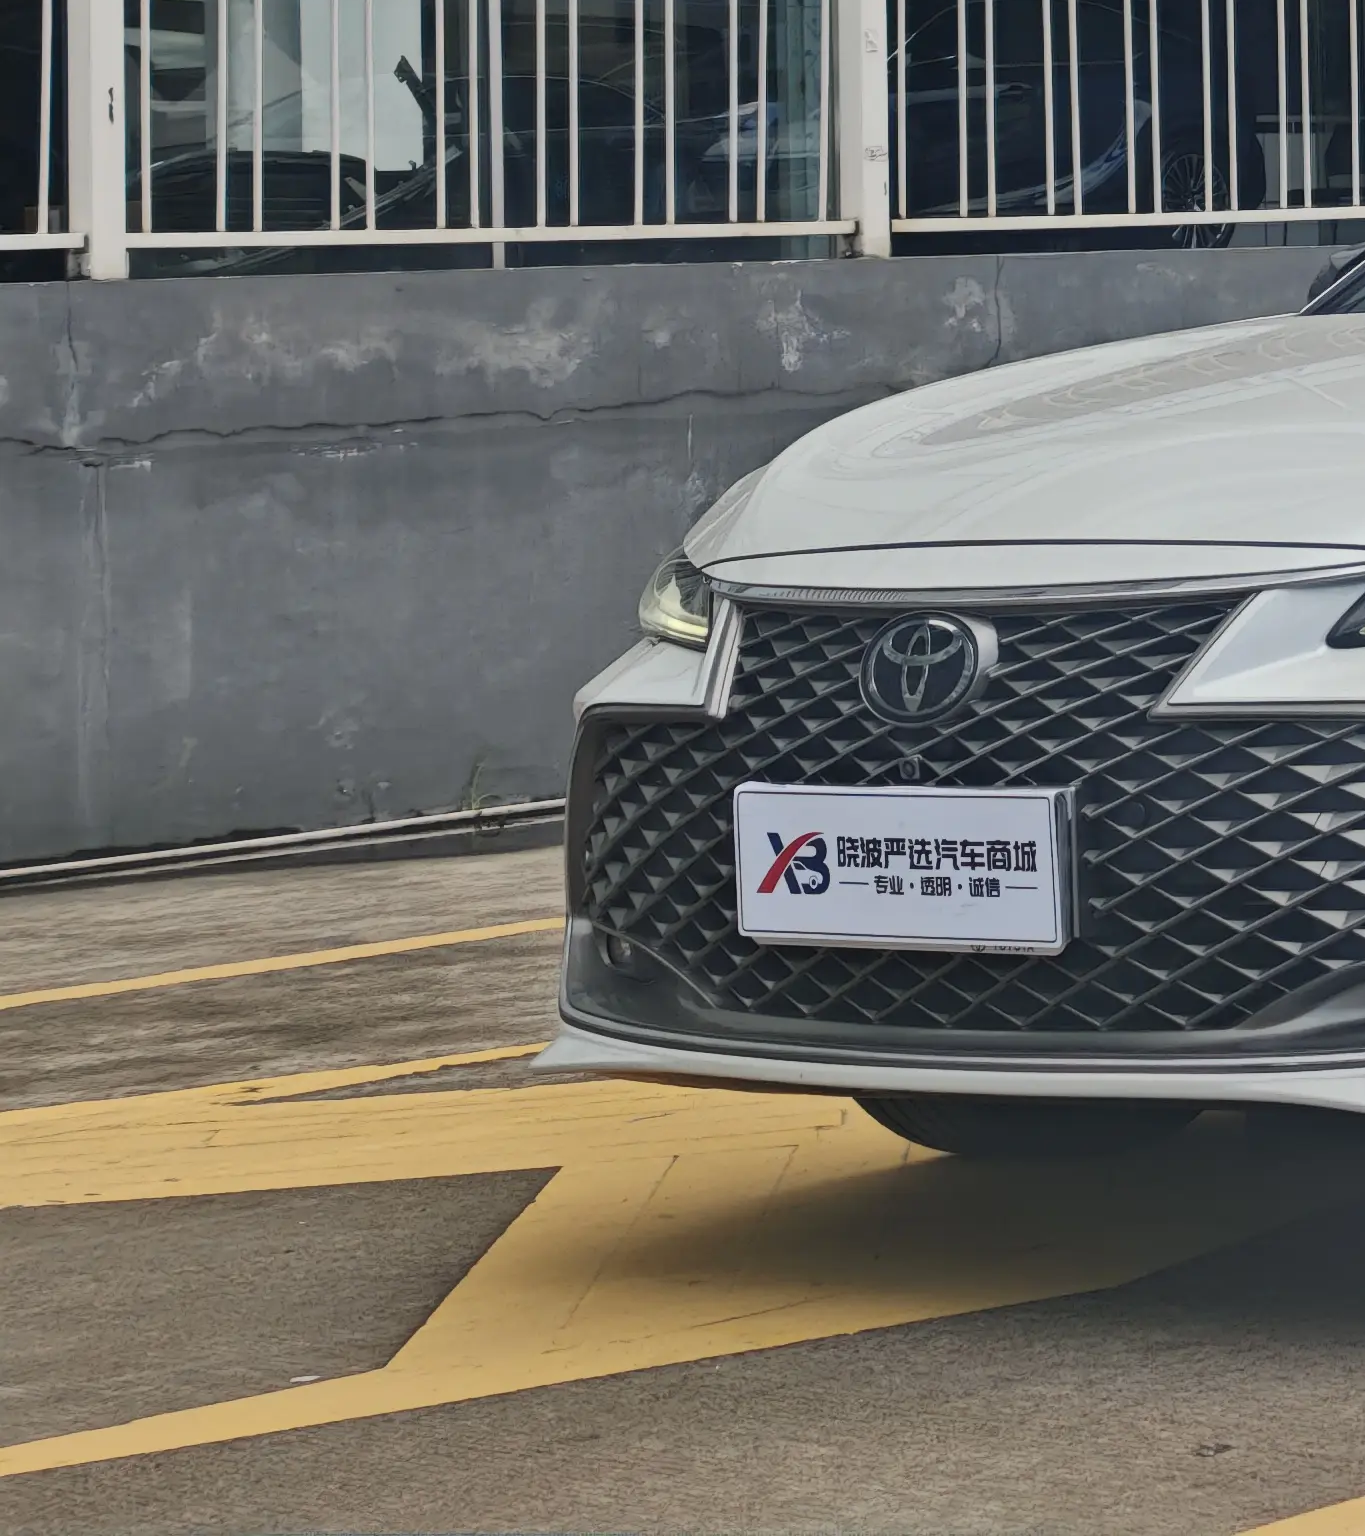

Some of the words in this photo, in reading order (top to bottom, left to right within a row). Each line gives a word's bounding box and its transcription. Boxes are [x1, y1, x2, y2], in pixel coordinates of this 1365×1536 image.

[836, 835, 1039, 872] 晓波严选汽车商城
